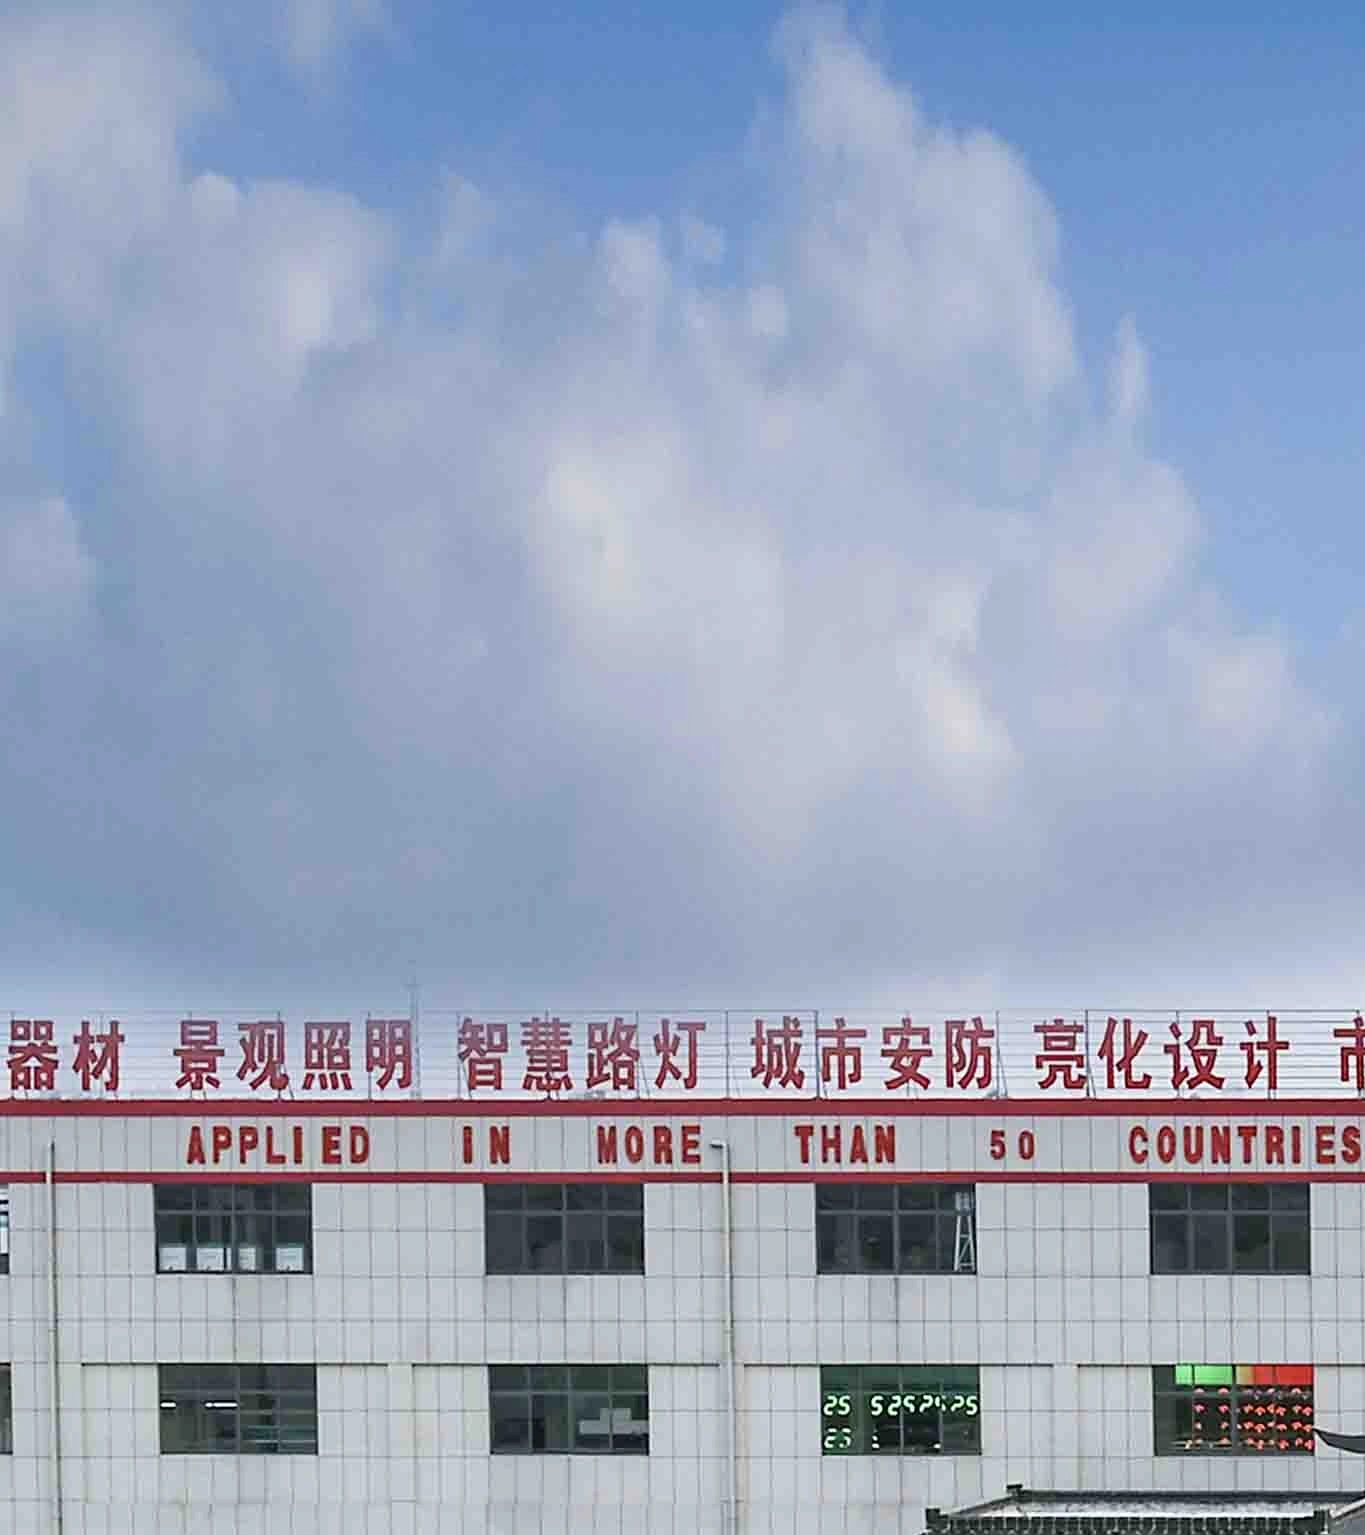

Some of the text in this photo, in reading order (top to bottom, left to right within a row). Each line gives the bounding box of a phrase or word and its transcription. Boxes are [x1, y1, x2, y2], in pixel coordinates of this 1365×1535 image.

[7, 1020, 125, 1091] 器材
[174, 1020, 413, 1091] 景观照明
[458, 1018, 706, 1091] 智慧路灯
[751, 1016, 996, 1090] 城市安防
[1033, 1016, 1290, 1090] 亮化设计
[187, 1124, 1362, 1166] APPLIED IN MORE THAN 50 COUNTRIES
